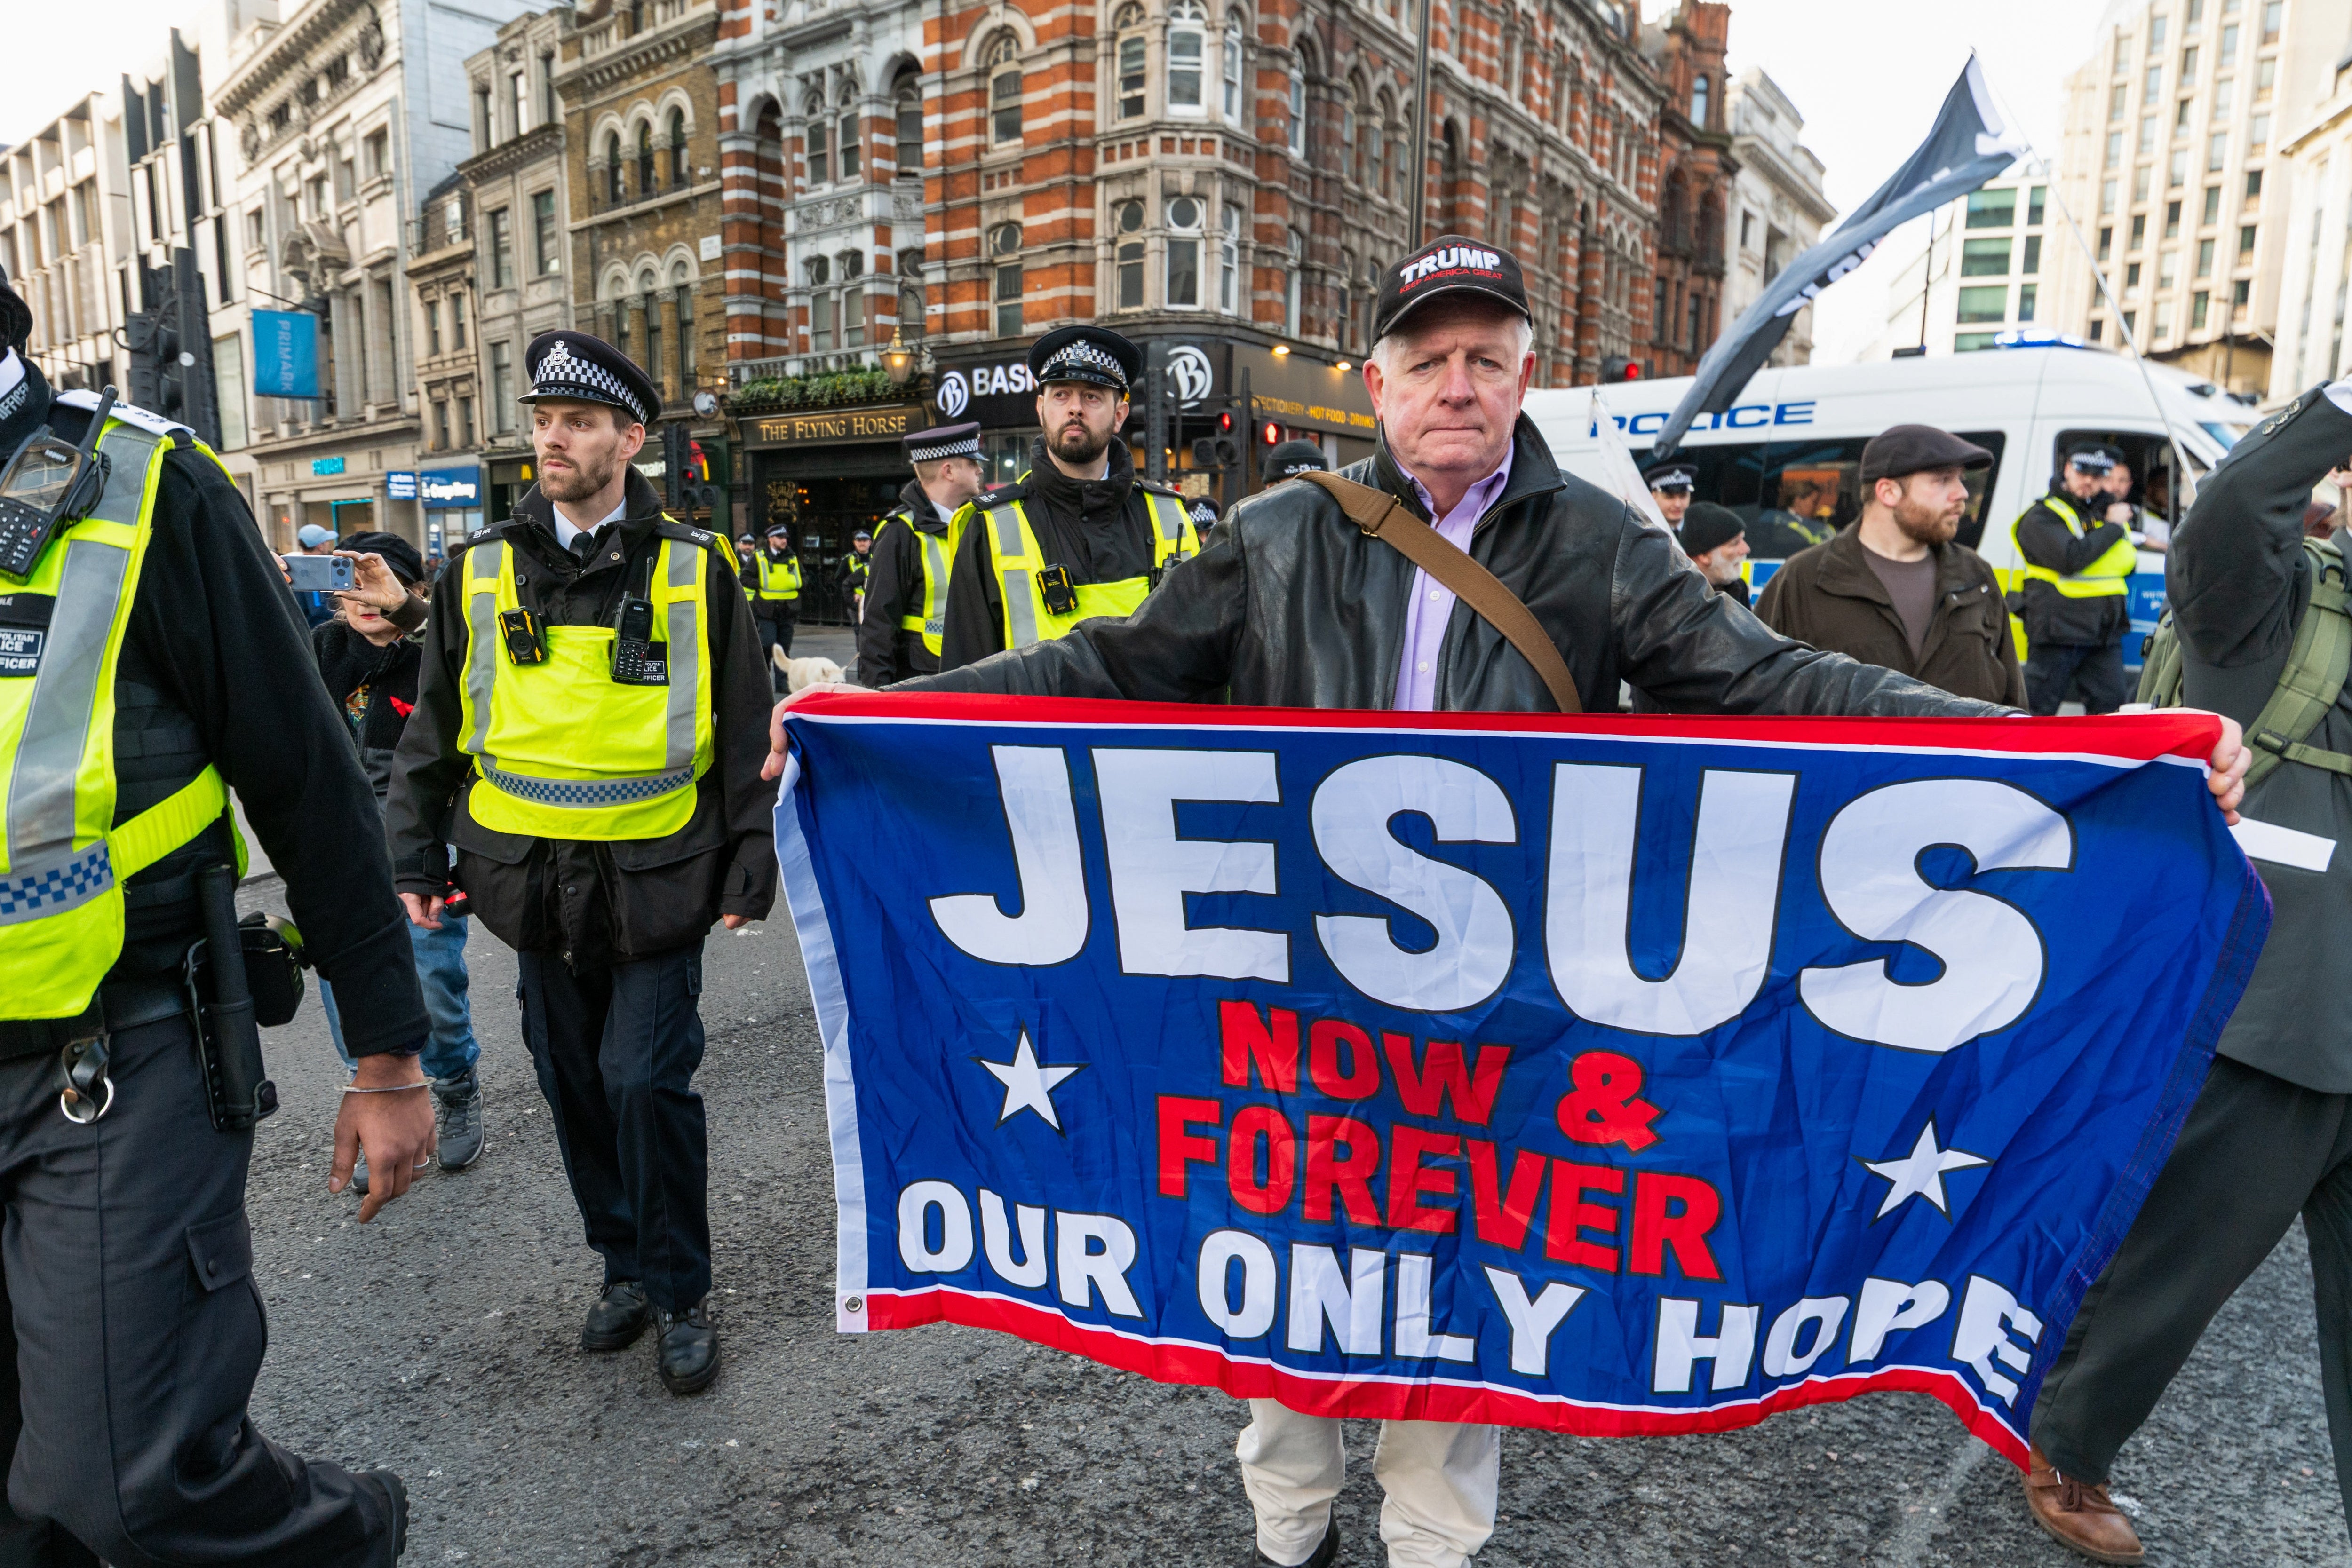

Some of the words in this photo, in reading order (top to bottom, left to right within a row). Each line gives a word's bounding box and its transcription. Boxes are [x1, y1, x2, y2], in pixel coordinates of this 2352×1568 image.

[1399, 279, 1422, 295] KEEP
[1423, 268, 1470, 282] AMERICA
[1472, 269, 1503, 280] GREAT
[1400, 247, 1501, 285] TRUMP
[277, 319, 294, 391] PRIMARK
[760, 424, 788, 441] THE
[795, 420, 846, 439] FLYING
[852, 416, 907, 436] HORSE
[1309, 405, 1325, 420] HOT
[1326, 407, 1346, 424] FOOD
[1350, 412, 1375, 429] DRINKS
[930, 744, 2075, 1053] JESUS
[1217, 999, 1512, 1125] NOW
[1556, 1049, 1668, 1154] &
[1155, 1093, 1725, 1284] FOREVER
[897, 1178, 1148, 1321] OUR
[1196, 1227, 1591, 1378] ONLY
[1649, 1273, 2045, 1408] HOPE
